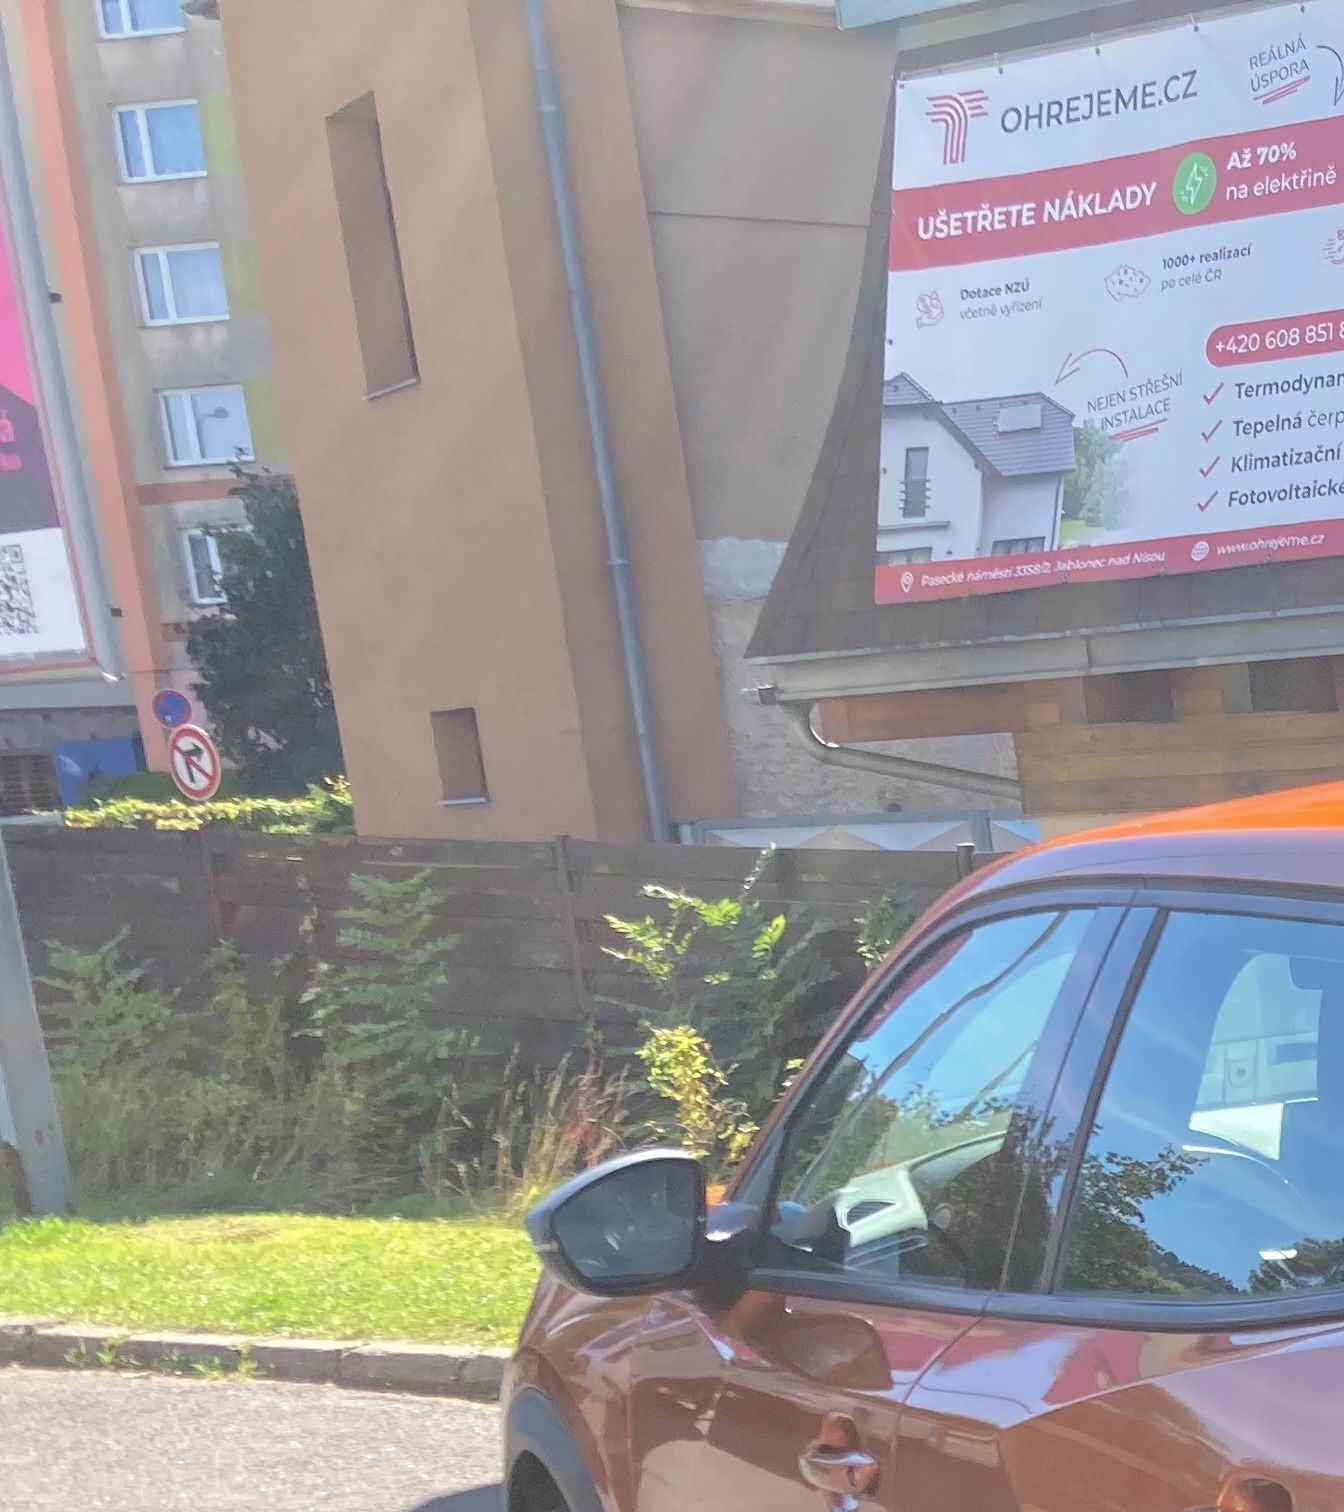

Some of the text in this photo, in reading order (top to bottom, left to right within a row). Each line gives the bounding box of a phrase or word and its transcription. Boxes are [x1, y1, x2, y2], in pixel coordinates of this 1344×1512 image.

[1249, 32, 1307, 71] REÁLNÁ
[1250, 58, 1310, 92] ÚSPORA
[1000, 69, 1198, 134] OHREJEME.CZ
[1226, 141, 1297, 171] Až 70%
[1226, 165, 1337, 201] na elektřině
[917, 181, 1157, 241] UŠETŘETE NÁKLADY
[1162, 242, 1252, 270] 1000+ realizací
[960, 286, 1002, 301] Dotace
[1161, 267, 1222, 293] po celé ČR
[1215, 334, 1260, 354] +420
[1264, 328, 1300, 348] 608
[1304, 322, 1333, 344] 851
[1087, 369, 1184, 413] NEJEN STŘEŠNÍ
[1101, 398, 1171, 431] INSTALACE
[1232, 414, 1302, 438] Tepelná
[1231, 442, 1341, 473] Klimatizační
[921, 572, 964, 587] Pasecké
[1108, 552, 1131, 567] nad
[1132, 551, 1166, 564] Nisou
